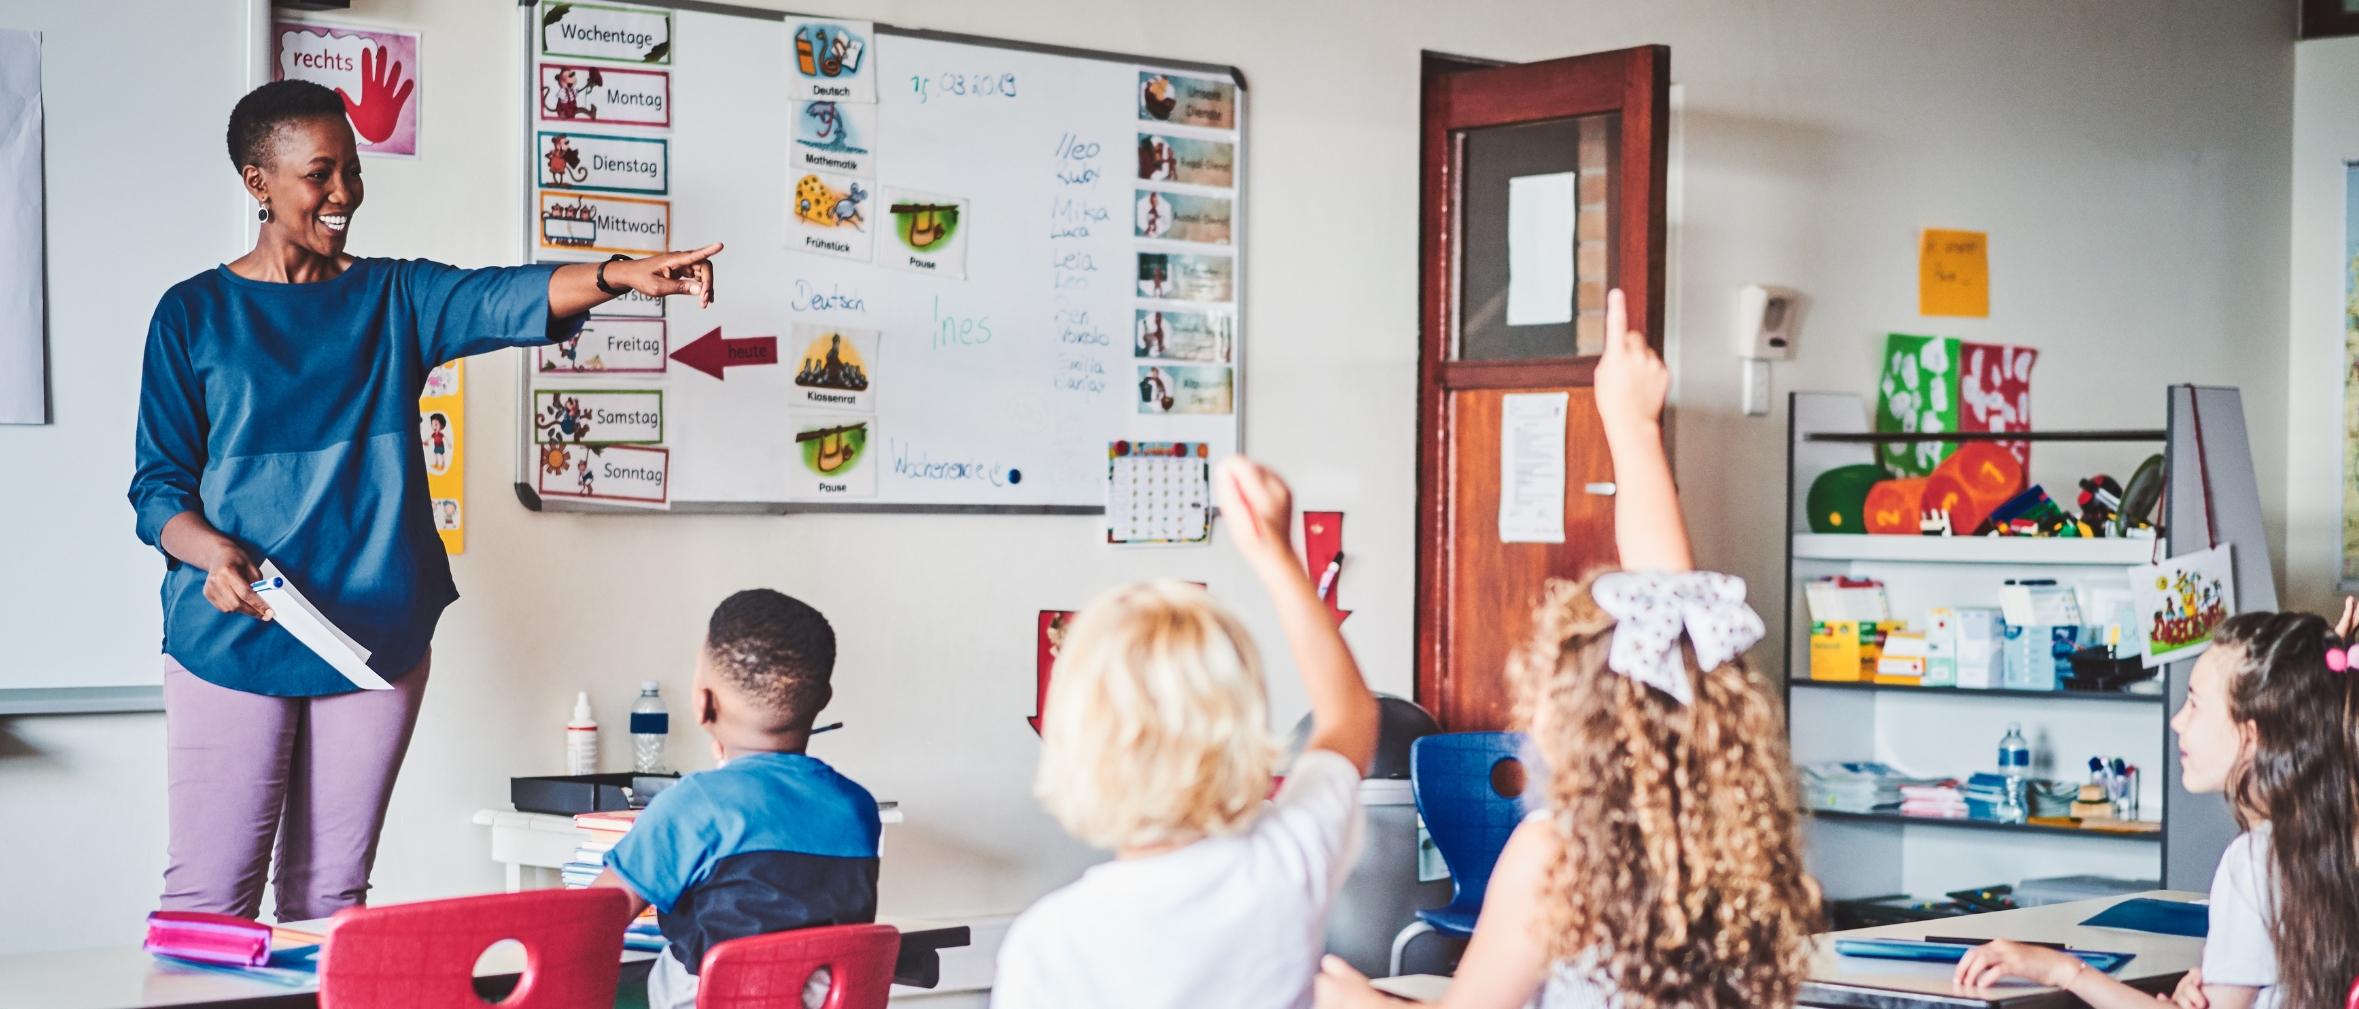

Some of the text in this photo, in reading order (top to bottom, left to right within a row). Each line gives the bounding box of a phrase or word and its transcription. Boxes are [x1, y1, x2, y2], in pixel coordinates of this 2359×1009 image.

[561, 23, 653, 48] Wochentage
[293, 48, 354, 73] rechts
[607, 88, 662, 109] Montag
[813, 84, 850, 97] Deutsch
[593, 154, 658, 178] Dienstag
[805, 153, 858, 170] Mathematik
[597, 214, 666, 236] Mittwoch
[806, 236, 850, 253] Frühstück
[910, 256, 936, 270] Pause
[791, 279, 865, 312] Deutsch
[933, 295, 992, 350] Ines
[607, 336, 660, 356] Freitag
[728, 343, 768, 359] heute
[808, 390, 856, 405] Klassenrat
[597, 408, 658, 428] Samstag
[604, 463, 663, 485] Sonntag
[818, 482, 847, 493] Pause
